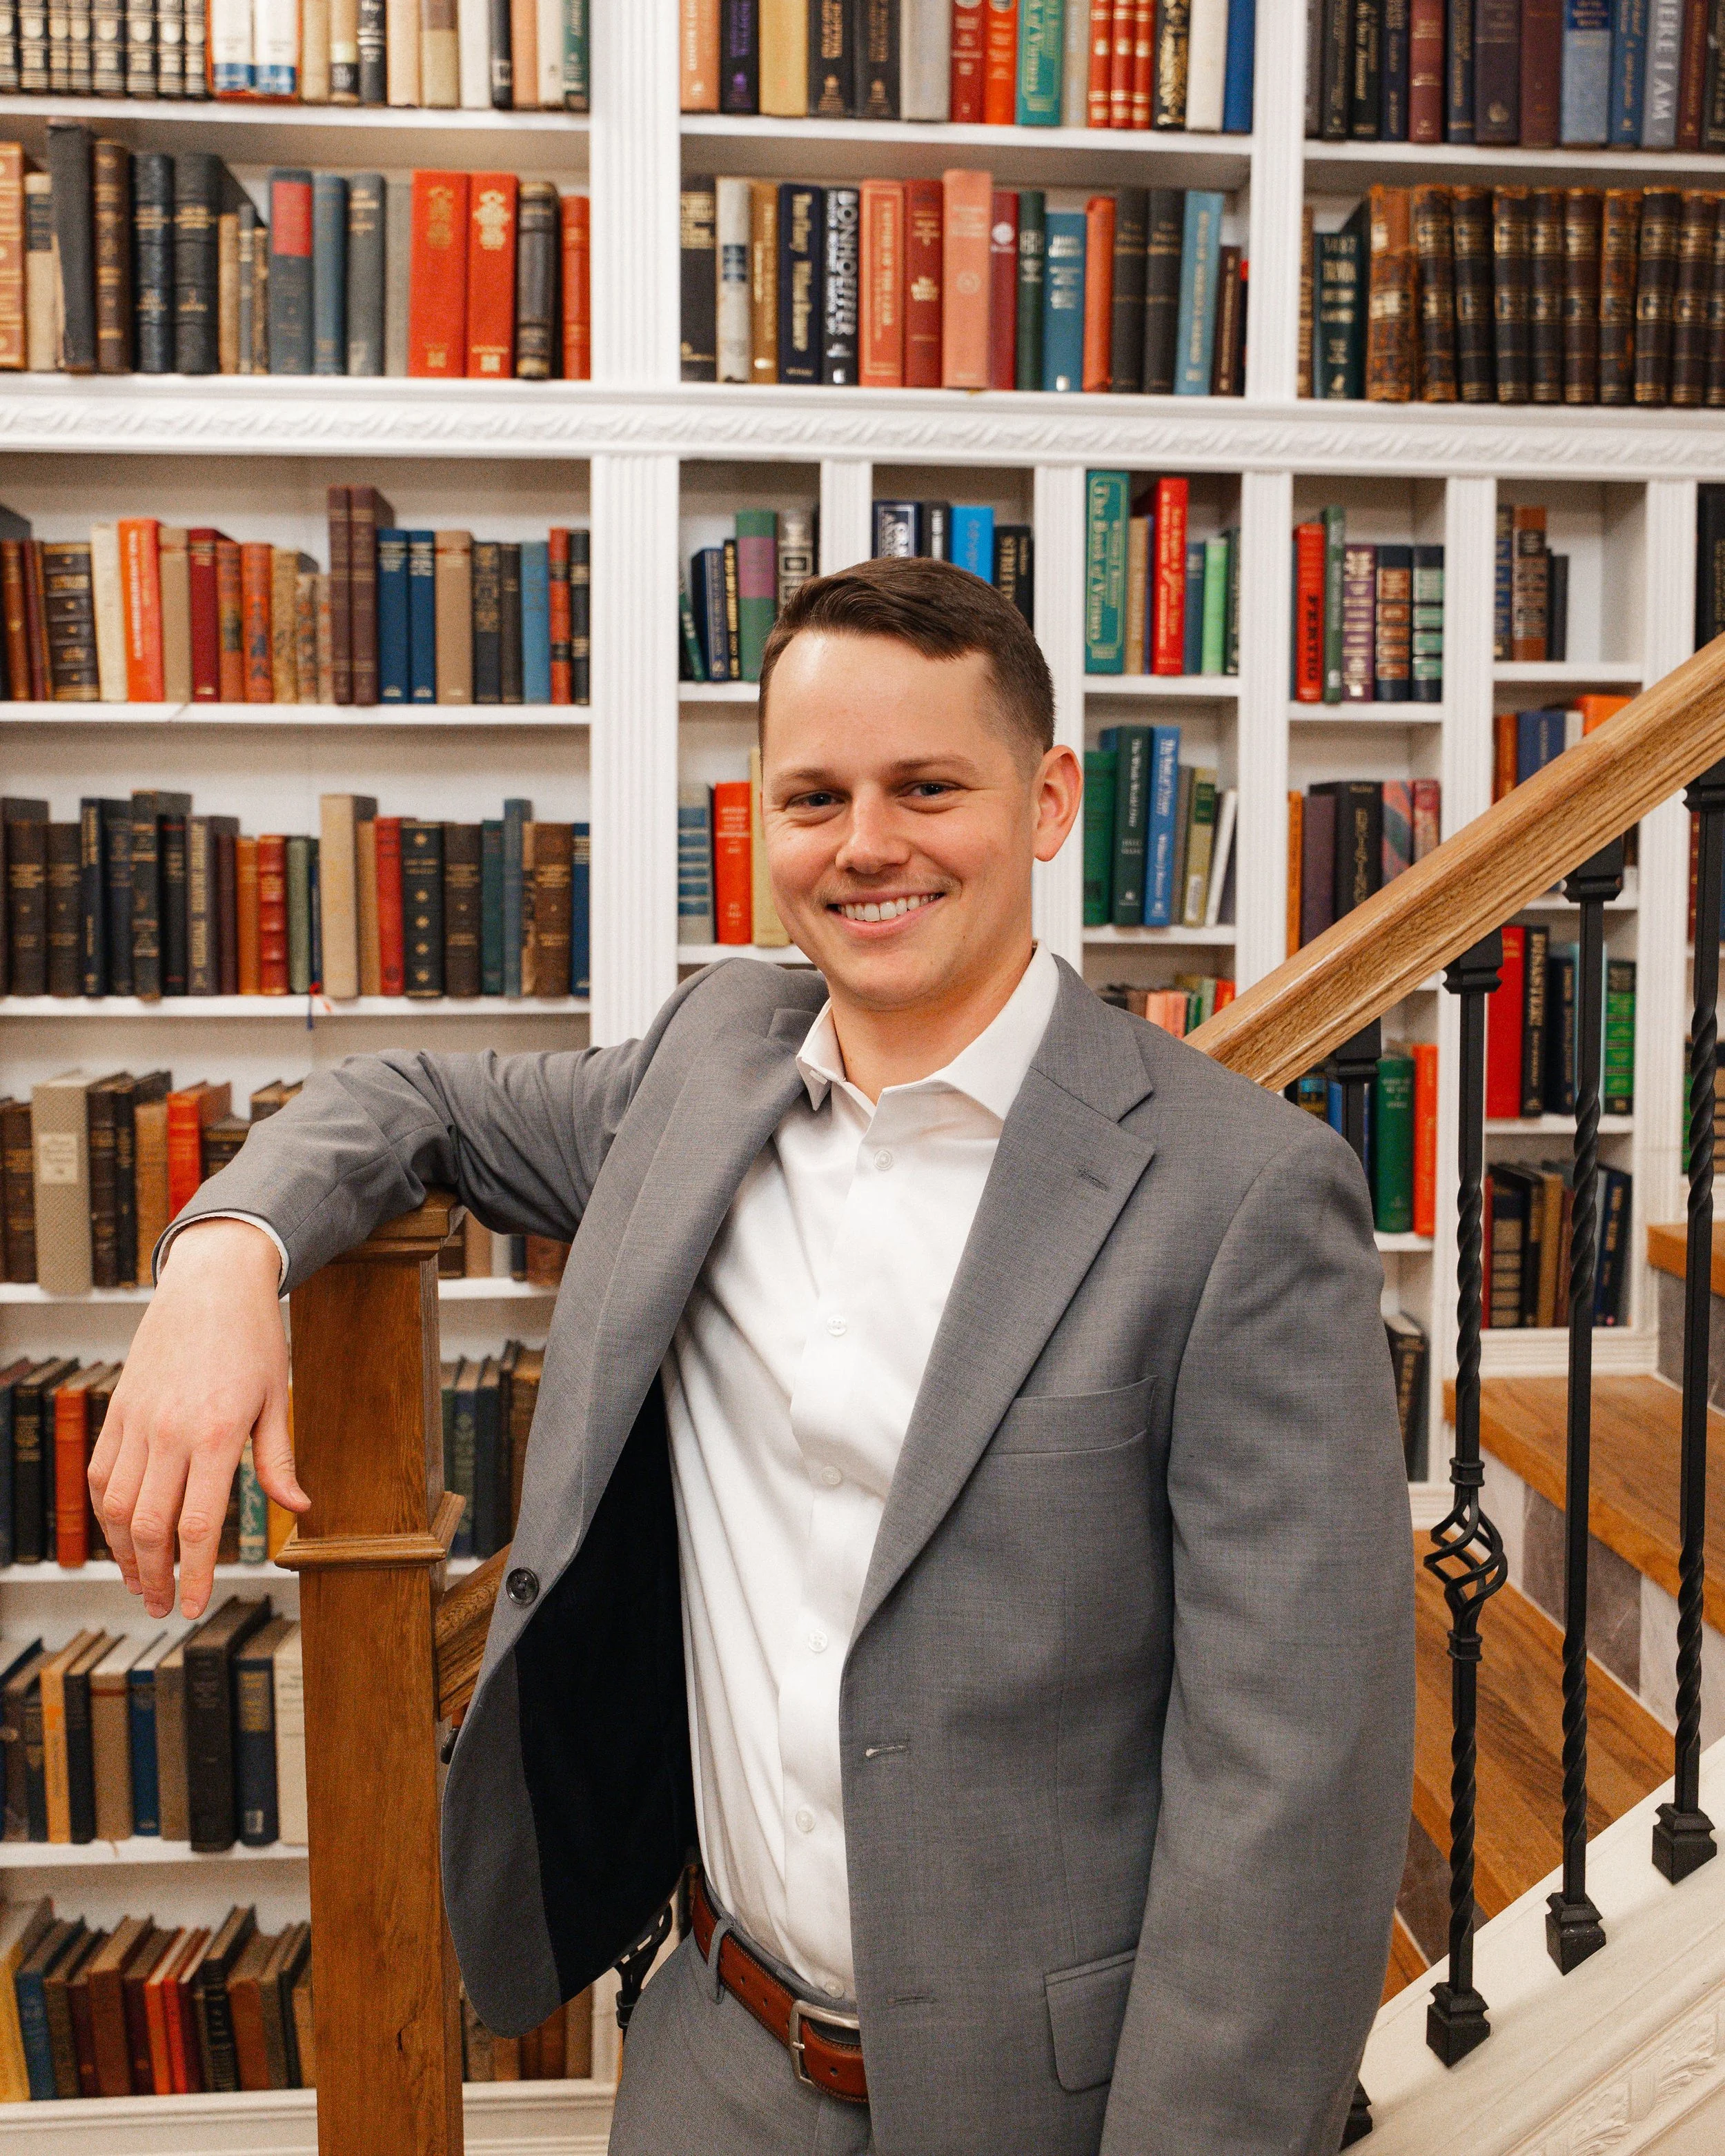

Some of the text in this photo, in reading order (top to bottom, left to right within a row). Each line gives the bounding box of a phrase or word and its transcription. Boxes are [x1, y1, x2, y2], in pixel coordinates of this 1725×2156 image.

[1657, 0, 1680, 54] ERE
[1653, 77, 1675, 120] AM
[836, 190, 858, 336] BONHOEFFER
